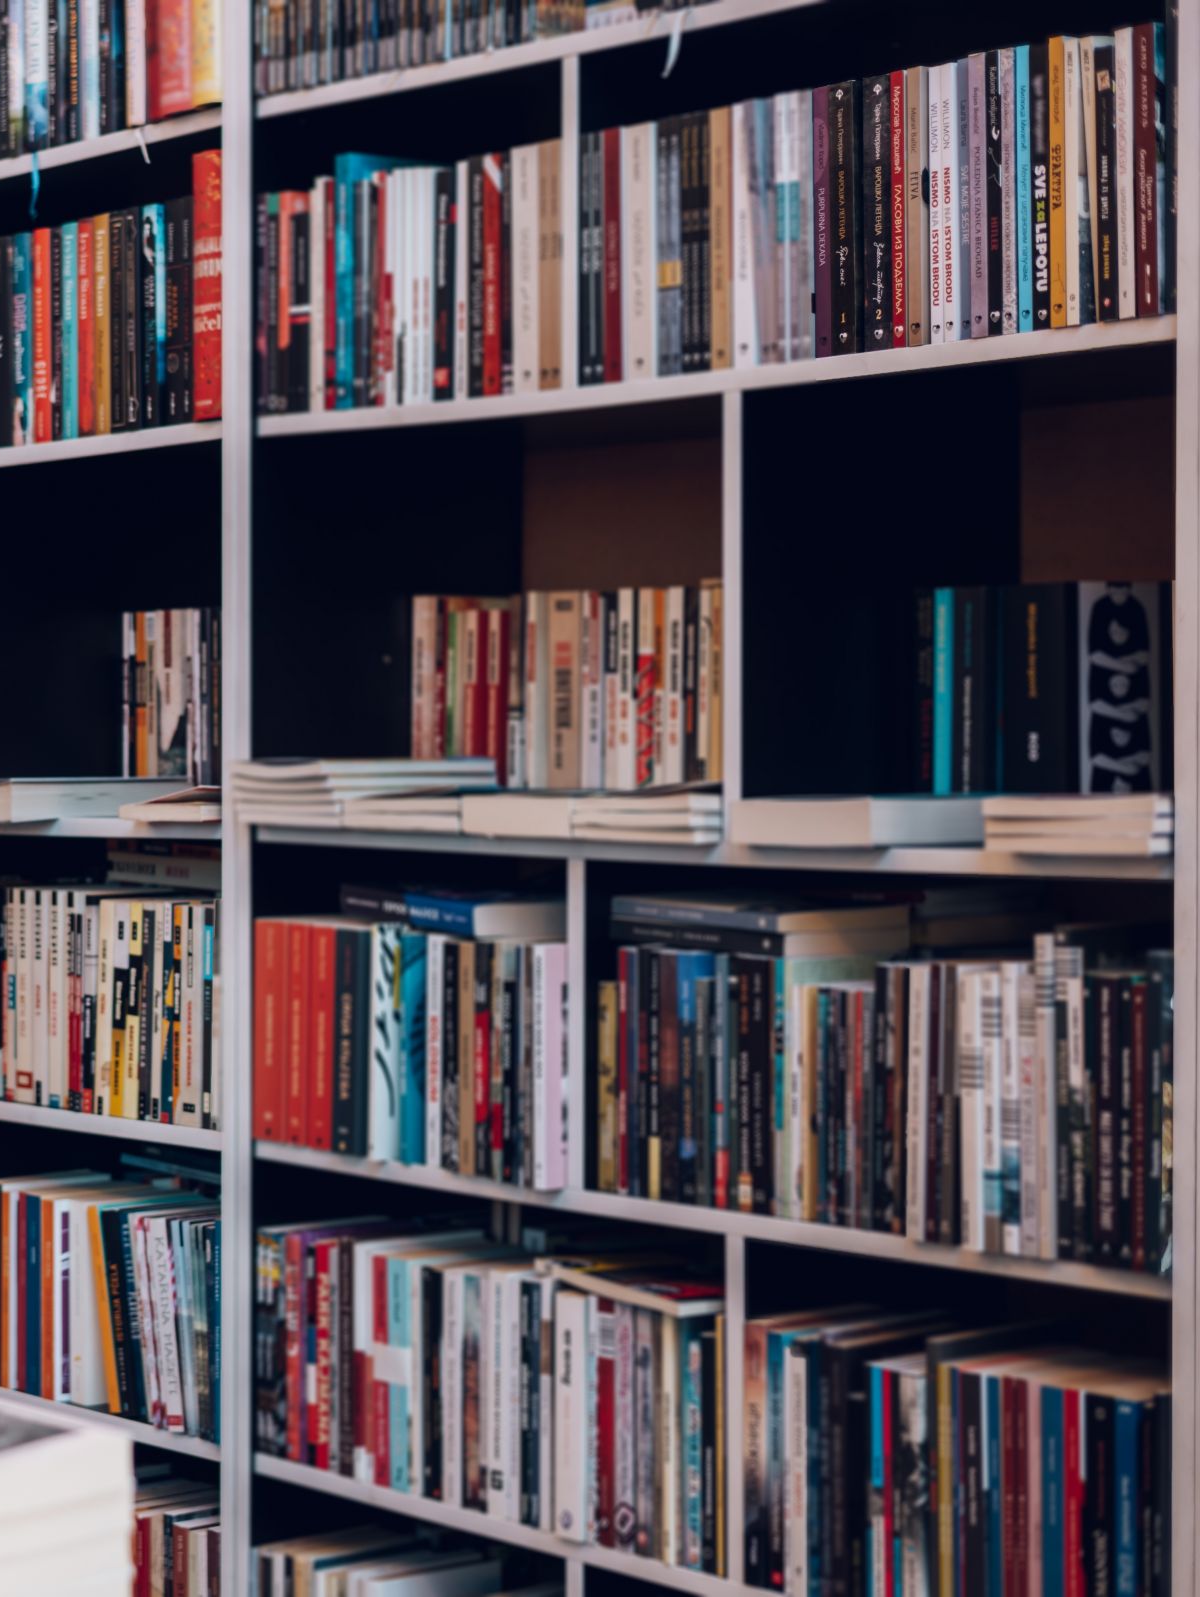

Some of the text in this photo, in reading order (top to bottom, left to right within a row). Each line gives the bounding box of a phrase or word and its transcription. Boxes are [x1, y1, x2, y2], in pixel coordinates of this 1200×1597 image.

[990, 67, 998, 96] Radomir
[1140, 37, 1149, 128] СИМО МАТАВУЉ
[892, 86, 902, 174] Мирослав Радошевић
[930, 103, 938, 153] WILLIMON
[942, 99, 951, 149] WILLIMON
[874, 166, 882, 236] ВАРОШКА ЛЕГЕНДА
[910, 171, 919, 200] FETVA
[960, 165, 969, 245] SVE MOJE SESTRE
[974, 146, 983, 278] POSLEDNJA STANICA BEOGRAD
[1051, 144, 1062, 211] ФРАКТУРА
[95, 229, 106, 272] Irving
[818, 187, 826, 266] PURPURNA DEKADA
[838, 208, 846, 239] ЛЕГЕНДА
[893, 184, 903, 315] ГЛАСОВИ ИЗ ПОДЗЕМЉА
[931, 171, 940, 306] NISMO NA ISTOM BRODU
[943, 167, 953, 303] NISMO NA ISTOM BRODU
[991, 217, 999, 251] HITLER
[1034, 165, 1048, 292] SVE za LEPOTU
[875, 309, 882, 319] 2
[154, 1236, 172, 1325] KATARINA
